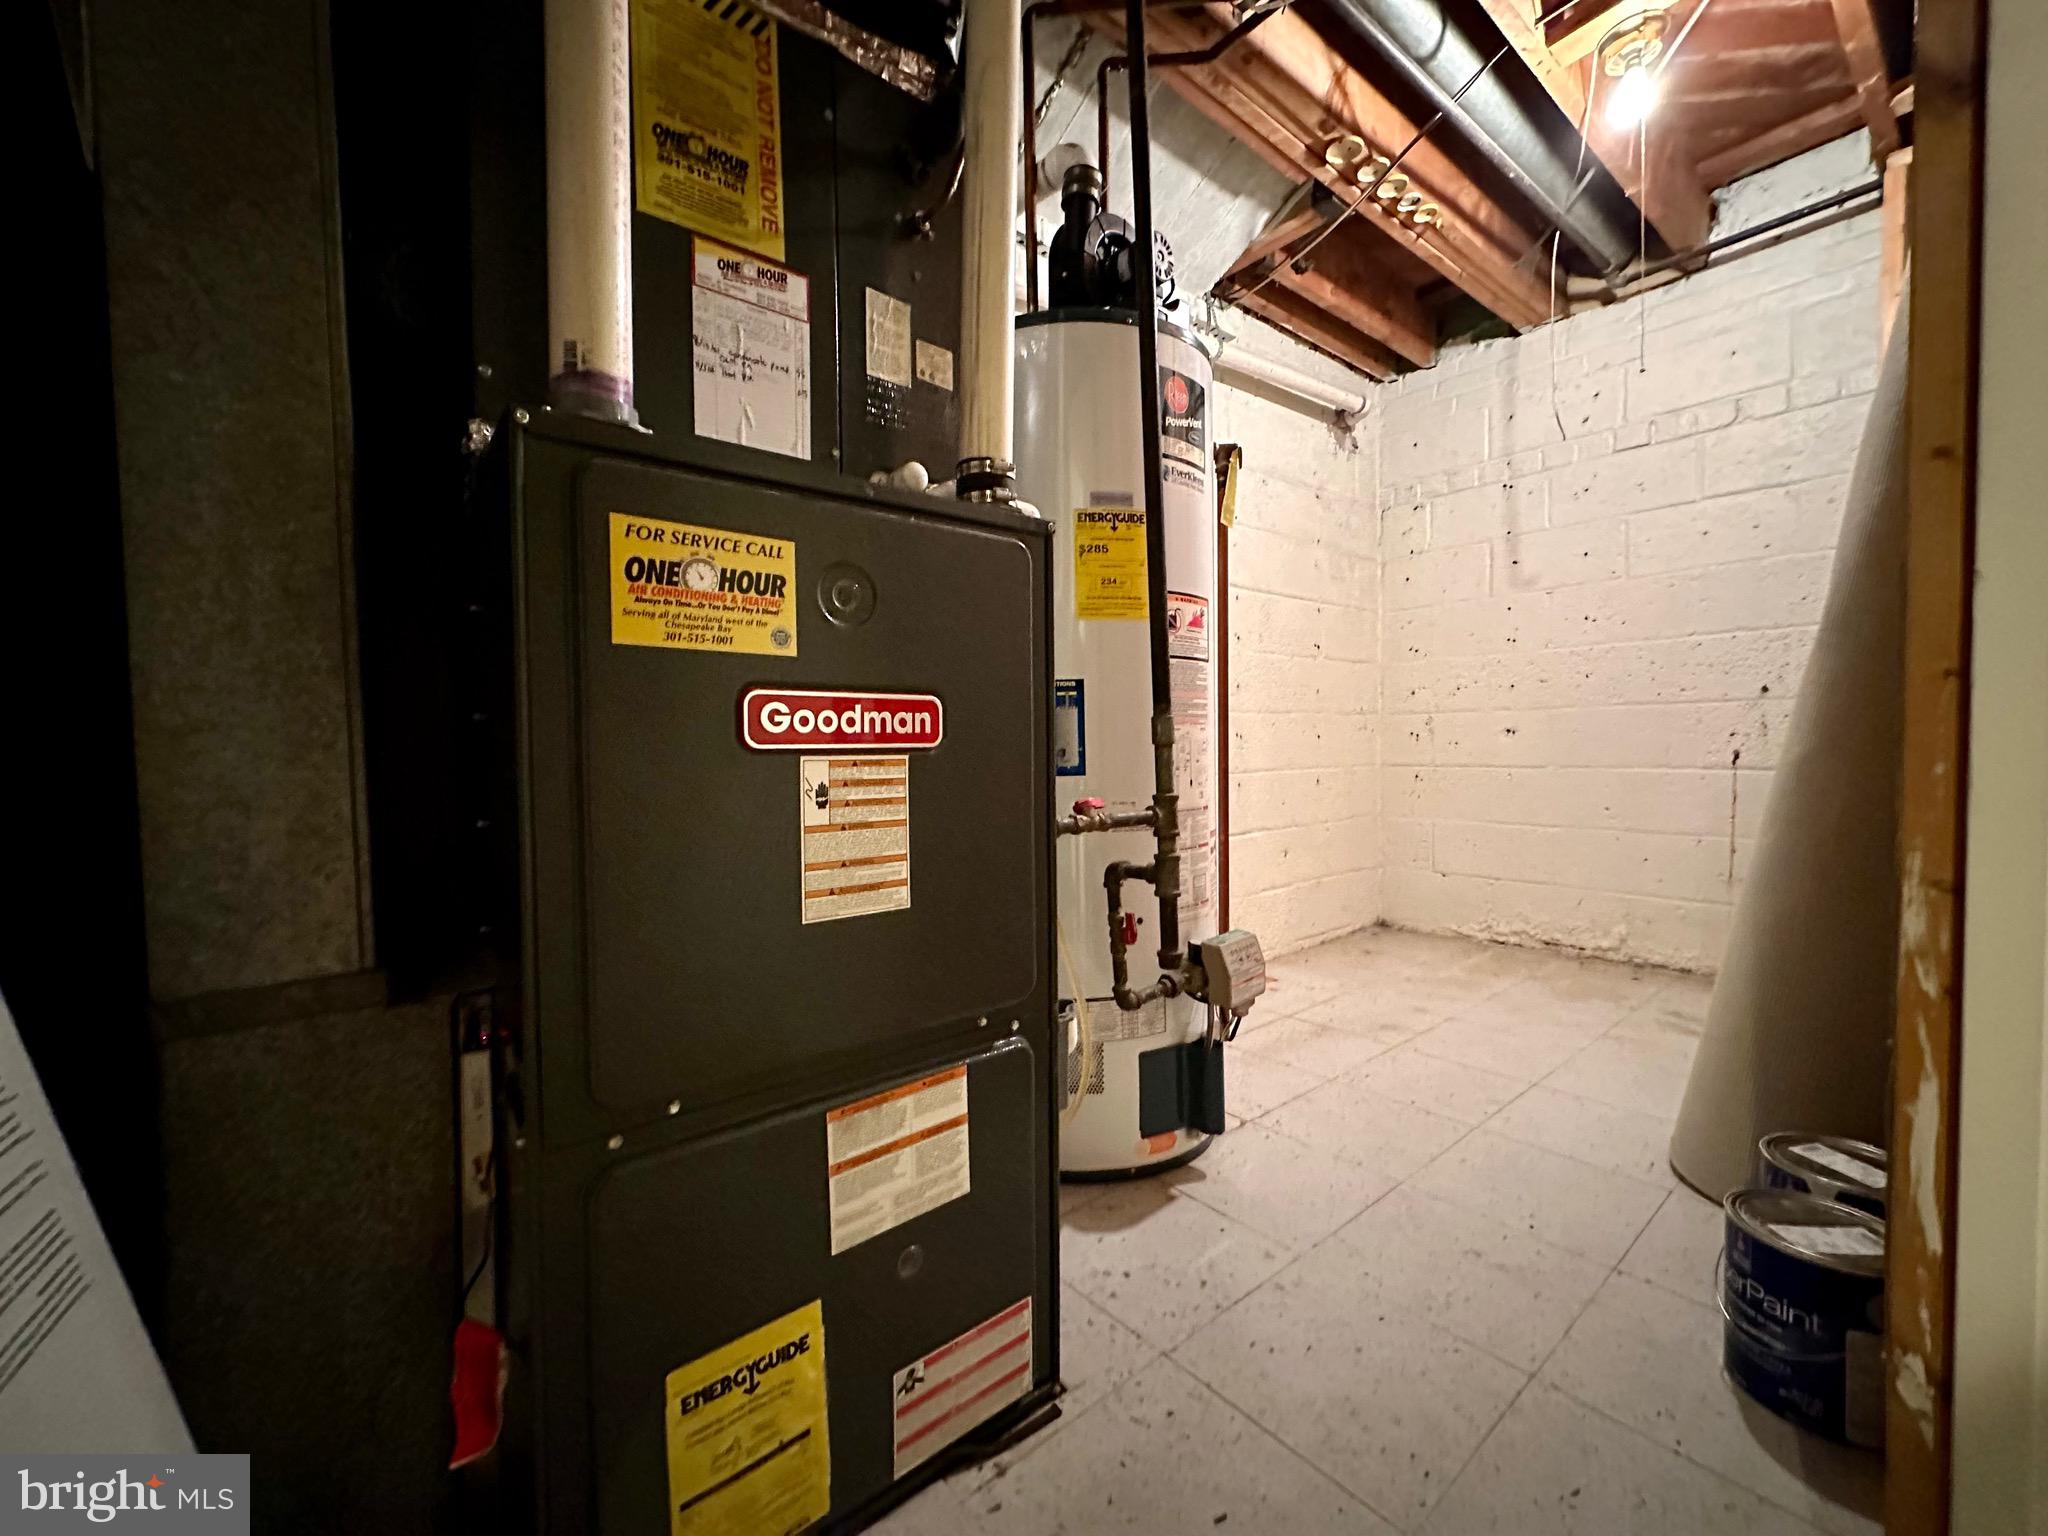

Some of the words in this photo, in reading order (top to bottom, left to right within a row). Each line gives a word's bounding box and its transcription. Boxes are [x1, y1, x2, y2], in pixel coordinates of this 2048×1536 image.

[756, 80, 775, 135] NOT
[652, 122, 688, 147] ONE
[707, 144, 750, 174] HOUR
[759, 133, 779, 236] REMOVE
[717, 258, 741, 274] ONE
[757, 266, 788, 285] HOUR
[1165, 415, 1202, 430] PowerVent
[1077, 512, 1146, 527] ENERGYGUIDE
[624, 523, 665, 542] FOR
[670, 531, 743, 553] SERVICE
[745, 541, 784, 560] CALL
[624, 556, 681, 587] ONE
[718, 567, 787, 599] HOUR
[628, 584, 648, 596] AIR
[651, 585, 727, 603] CONDITIONING
[731, 596, 738, 606] &
[741, 596, 782, 609] HEATING
[634, 595, 661, 606] Always
[663, 598, 674, 606] On
[622, 607, 656, 620] Serving
[658, 610, 669, 620] all
[672, 611, 682, 621] of
[683, 613, 723, 625] Maryland
[725, 617, 744, 627] west
[745, 618, 755, 627] of
[756, 619, 768, 628] the
[665, 620, 715, 632] Chesapeake
[717, 624, 732, 634] Bay
[664, 631, 734, 645] 301-515-1001
[760, 701, 932, 735] Goodman
[680, 1333, 811, 1416] ENERGYGUIDE
